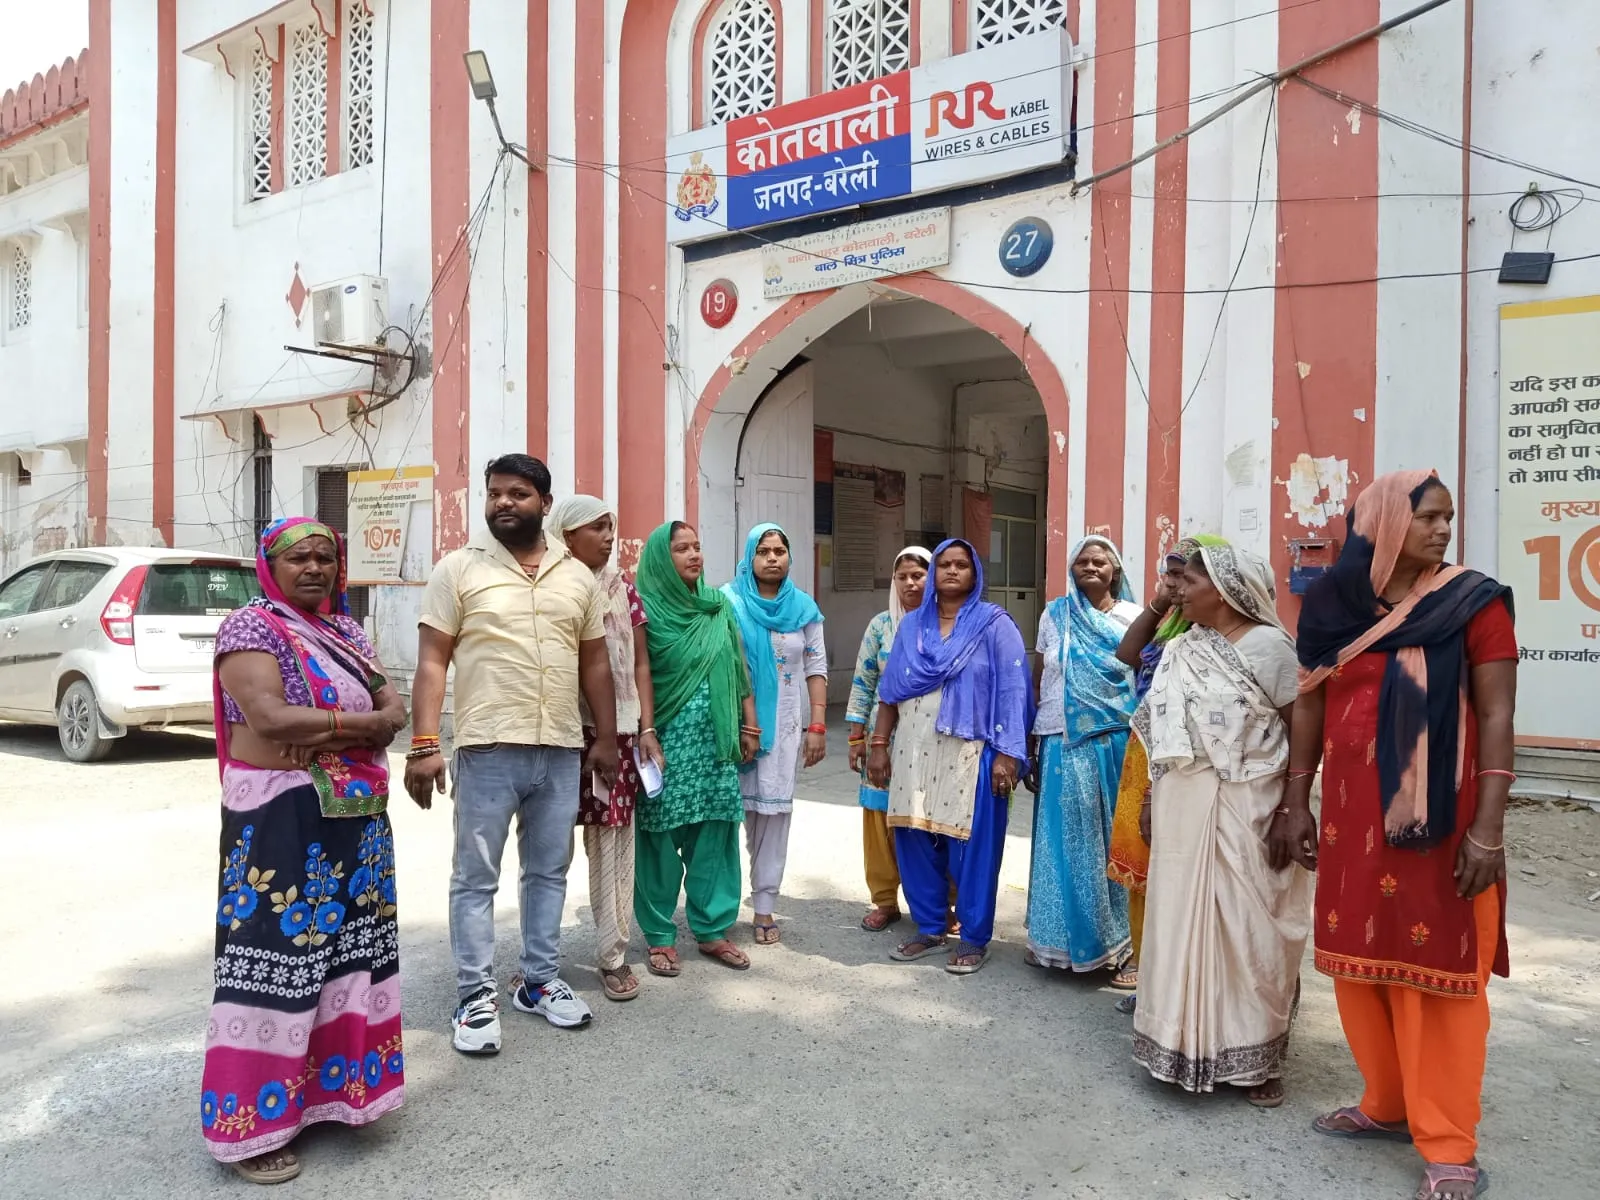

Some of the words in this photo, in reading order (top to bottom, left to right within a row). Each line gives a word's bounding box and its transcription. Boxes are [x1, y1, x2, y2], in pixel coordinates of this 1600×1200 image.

[925, 81, 1006, 138] RR
[736, 83, 899, 172] कोतवाली
[925, 139, 971, 160] WIRES
[976, 136, 985, 149] &
[990, 121, 1050, 145] CABLES
[1005, 230, 1040, 260] 27
[814, 260, 838, 273] बाल
[869, 246, 906, 265] पुलिस
[704, 290, 726, 314] 19
[1509, 375, 1544, 392] यदि
[1548, 377, 1578, 392] इस
[1509, 397, 1570, 415] आपकी
[1508, 426, 1532, 437] का
[1508, 444, 1542, 461] नहीं
[1546, 444, 1566, 460] हो
[1570, 446, 1590, 458] पा
[1508, 468, 1528, 483] तो
[1532, 469, 1568, 482] आप
[363, 526, 401, 551] 1076
